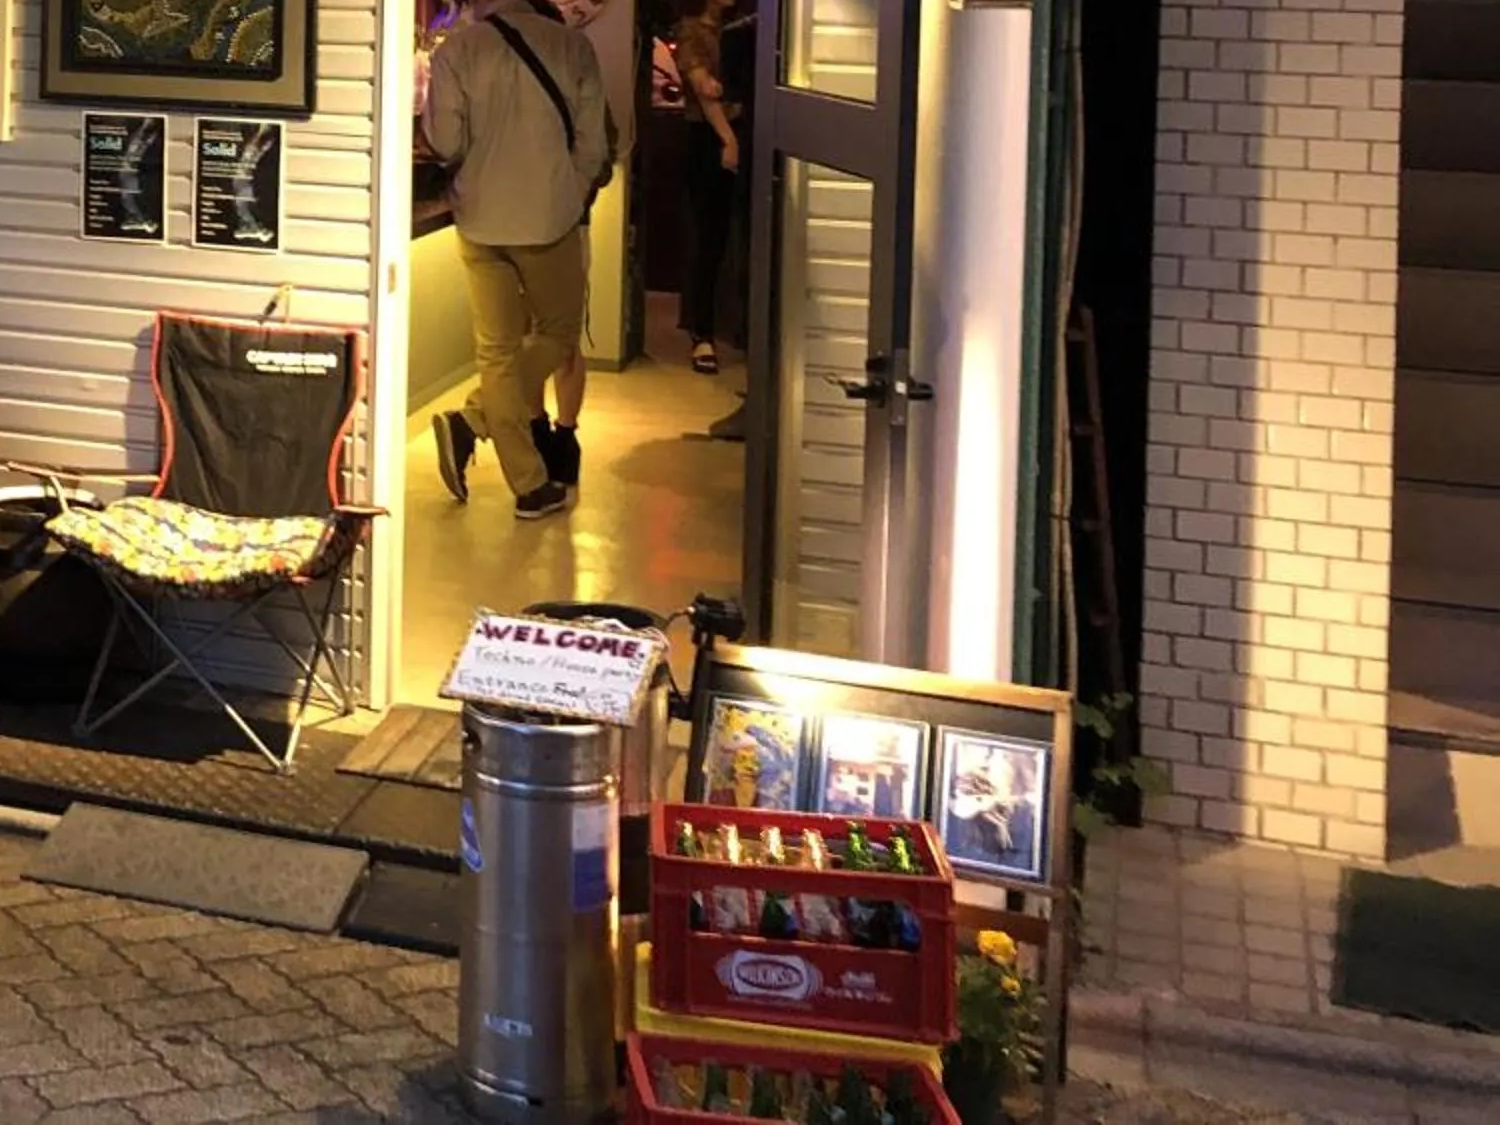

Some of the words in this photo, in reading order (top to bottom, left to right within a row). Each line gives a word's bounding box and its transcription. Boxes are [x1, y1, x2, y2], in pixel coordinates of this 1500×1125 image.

[89, 136, 123, 151] Solid
[202, 142, 237, 157] Solid
[481, 621, 640, 660] WELCOME
[457, 670, 549, 695] Entrance
